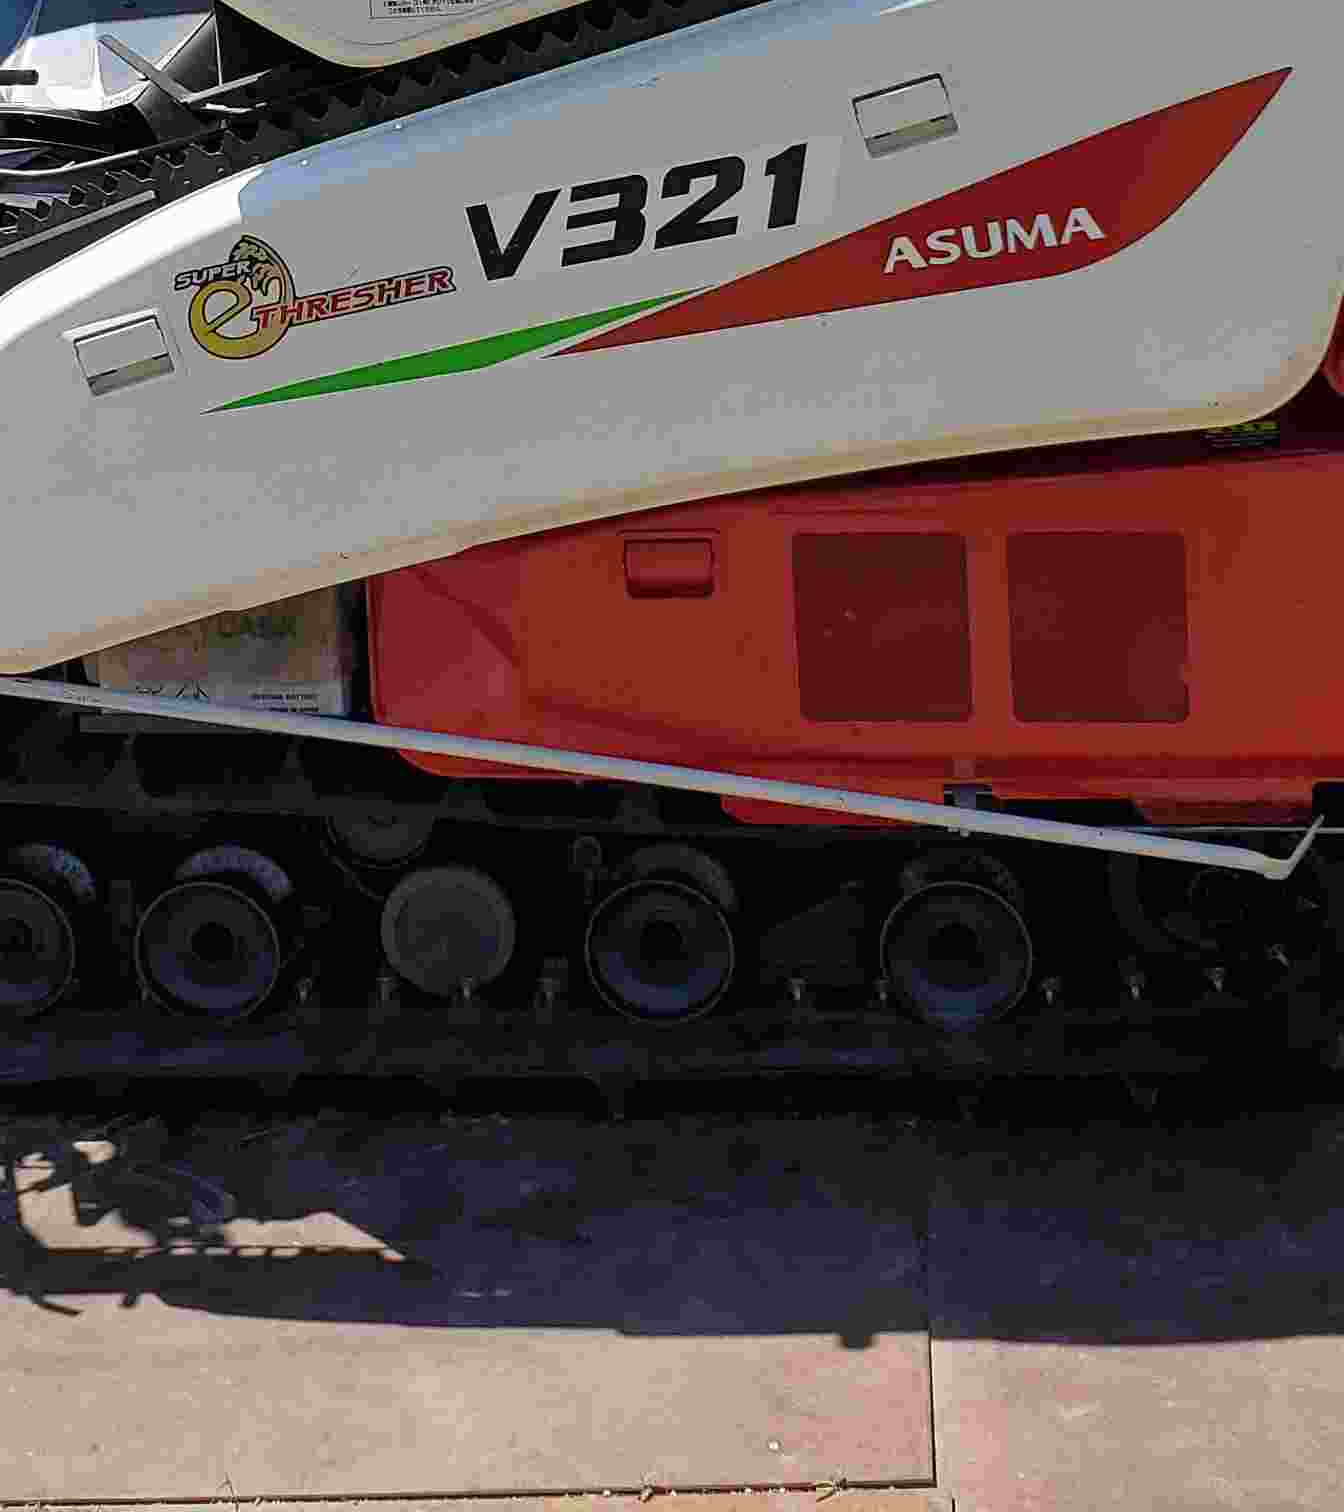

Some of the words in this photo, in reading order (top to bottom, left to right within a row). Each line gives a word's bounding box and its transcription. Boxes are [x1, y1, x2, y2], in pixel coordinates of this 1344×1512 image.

[465, 143, 808, 282] V321
[883, 206, 1106, 275] ASUMA
[174, 261, 256, 291] SUPER
[253, 269, 453, 331] THRESHER
